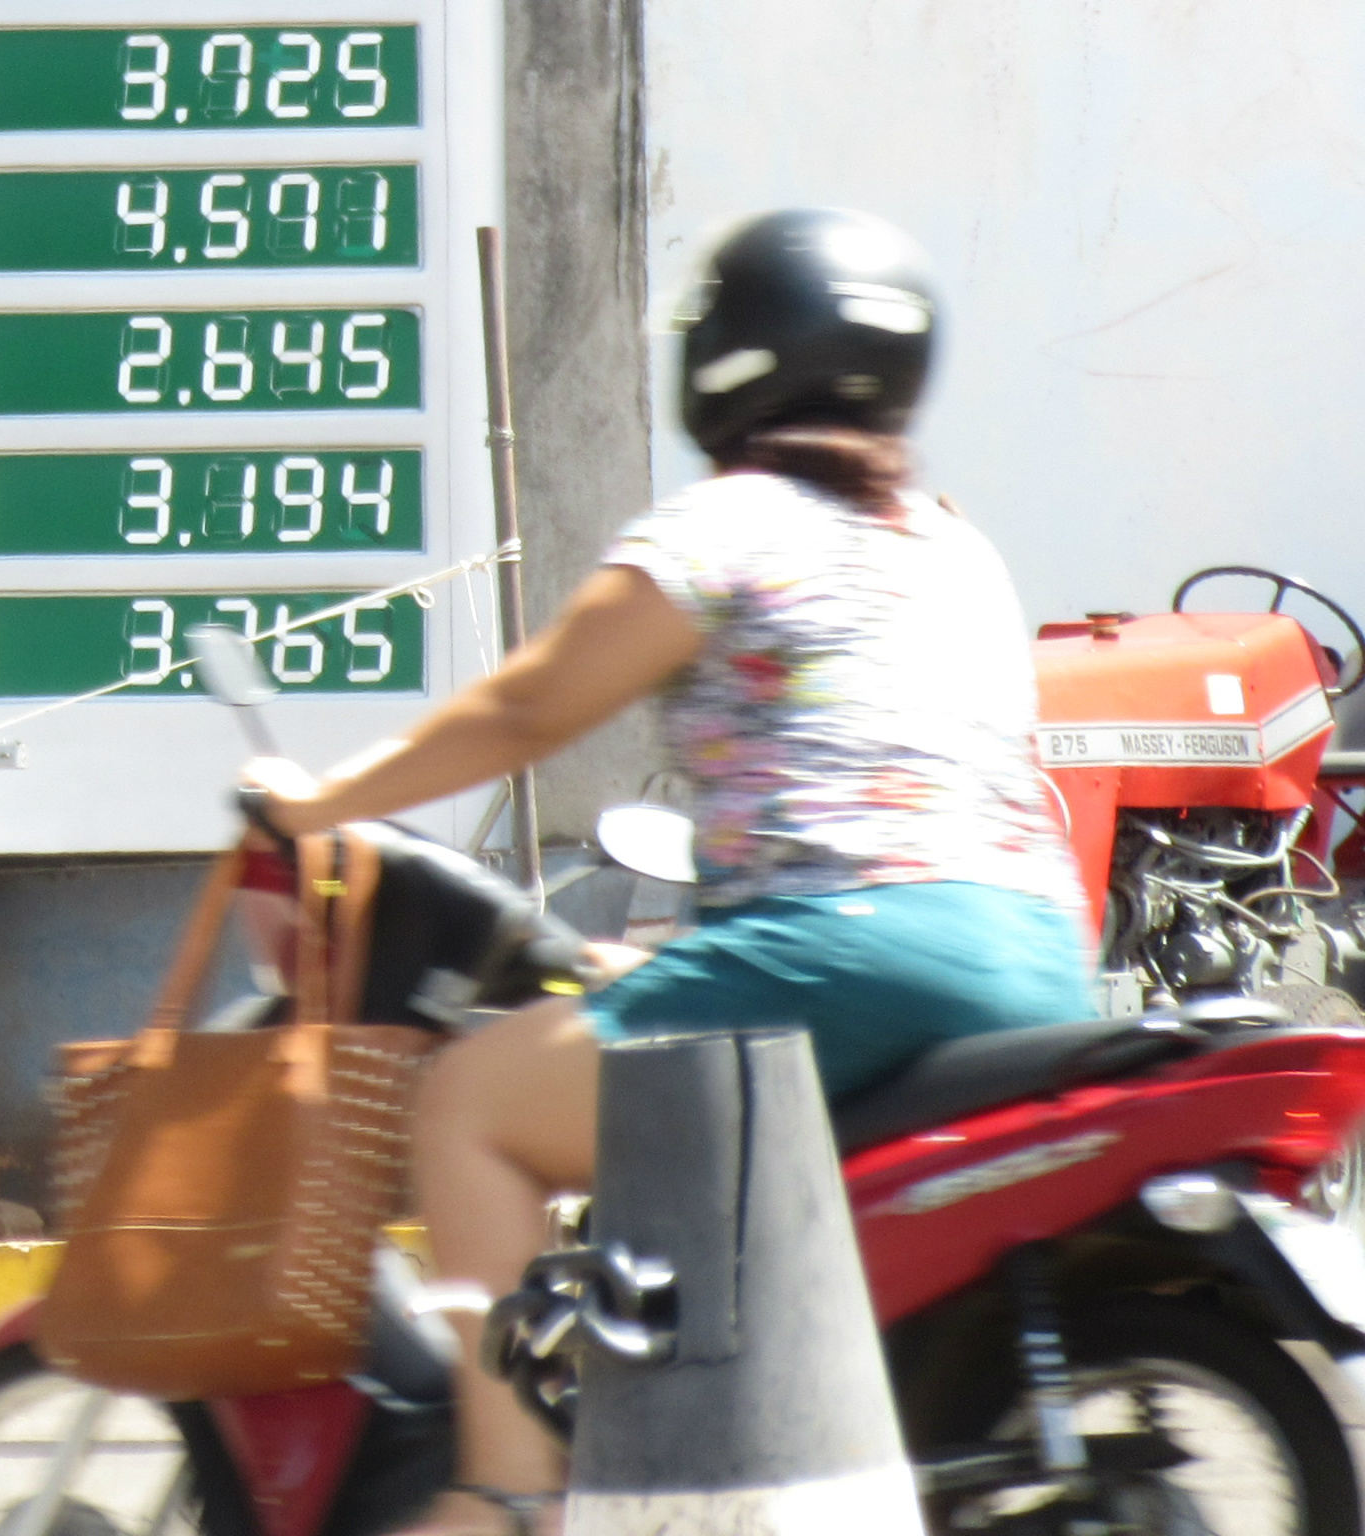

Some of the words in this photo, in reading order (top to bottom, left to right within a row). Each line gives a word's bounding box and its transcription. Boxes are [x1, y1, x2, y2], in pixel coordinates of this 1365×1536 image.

[121, 34, 387, 122] 3.725
[116, 174, 387, 264] 4.571
[118, 315, 389, 407] 2.645
[123, 458, 394, 548] 3.194
[1050, 734, 1089, 756] 275
